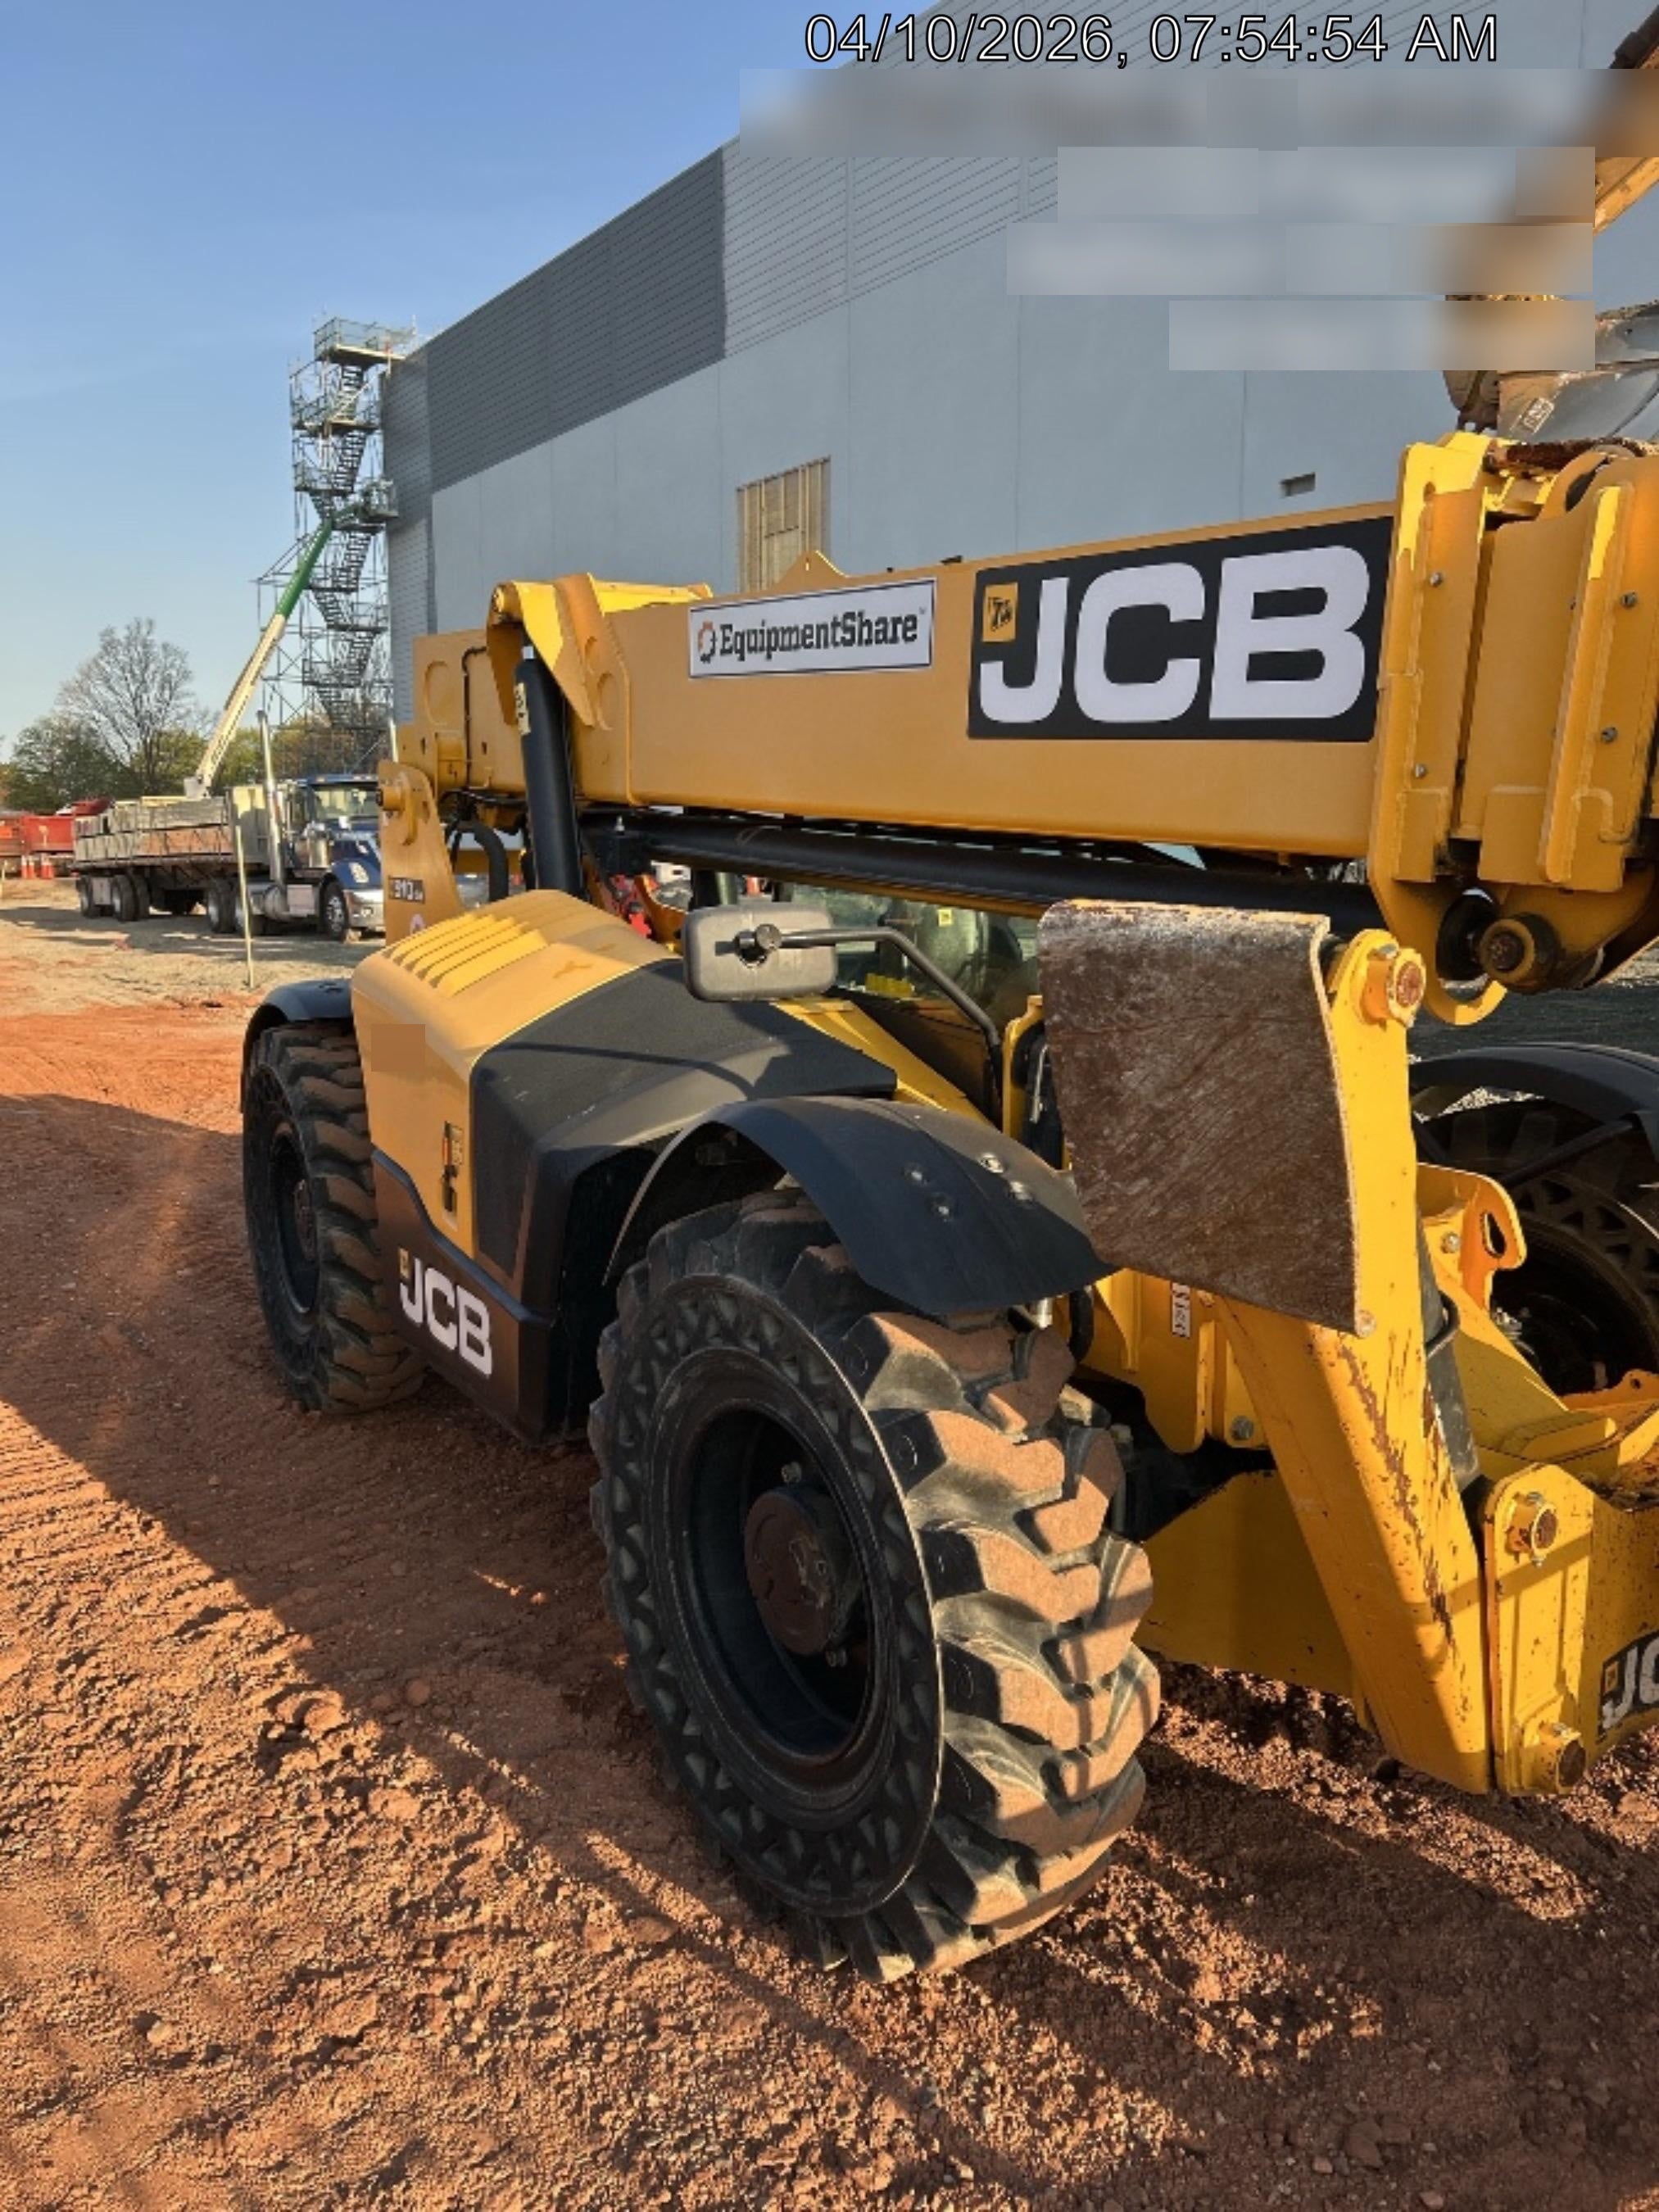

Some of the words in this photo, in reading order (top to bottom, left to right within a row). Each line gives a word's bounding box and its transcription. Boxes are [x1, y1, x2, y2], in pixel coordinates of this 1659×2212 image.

[719, 610, 918, 662] EquipmentShare
[980, 545, 1370, 723] JCB
[400, 1257, 492, 1376] JCB
